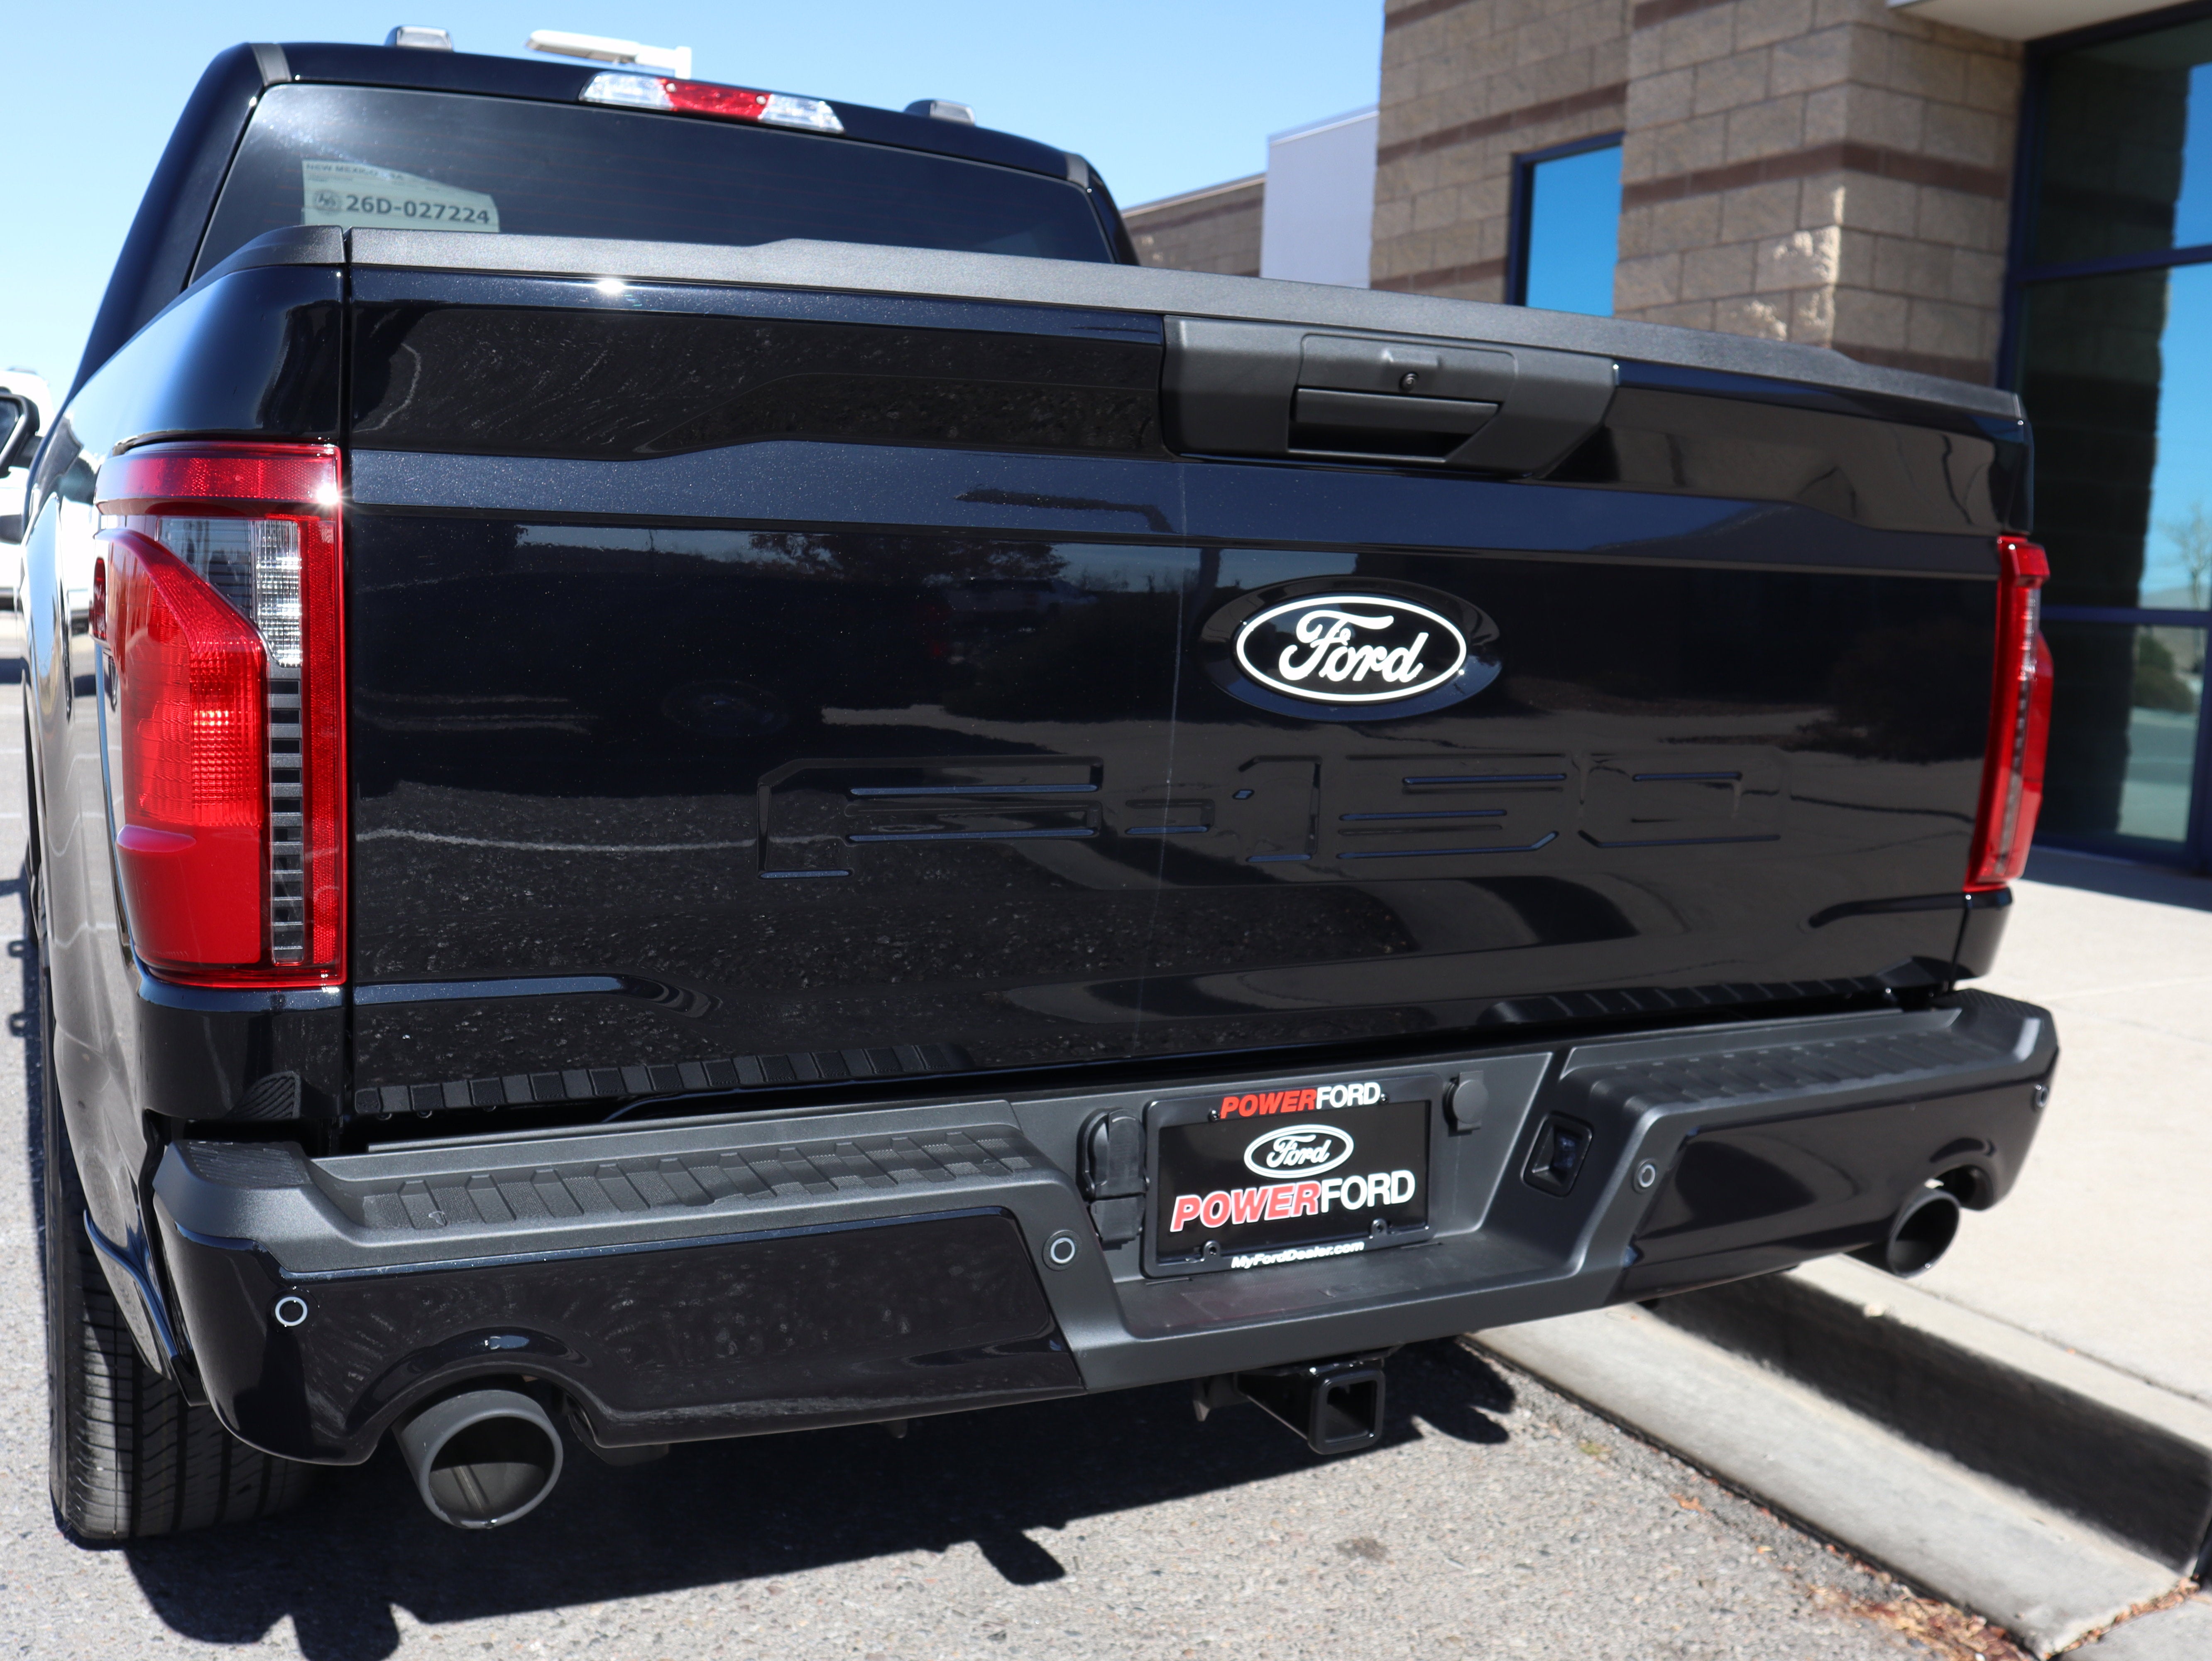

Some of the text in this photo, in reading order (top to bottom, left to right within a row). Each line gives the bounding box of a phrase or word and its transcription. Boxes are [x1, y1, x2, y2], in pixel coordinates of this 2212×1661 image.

[346, 194, 490, 224] 26D-027224
[1279, 610, 1429, 683] Ford
[1219, 1082, 1380, 1119] POWERFORD
[1266, 1134, 1332, 1168] Ford
[1170, 1170, 1416, 1232] POWERFORD
[1231, 1241, 1364, 1269] MyFordDealer.com
